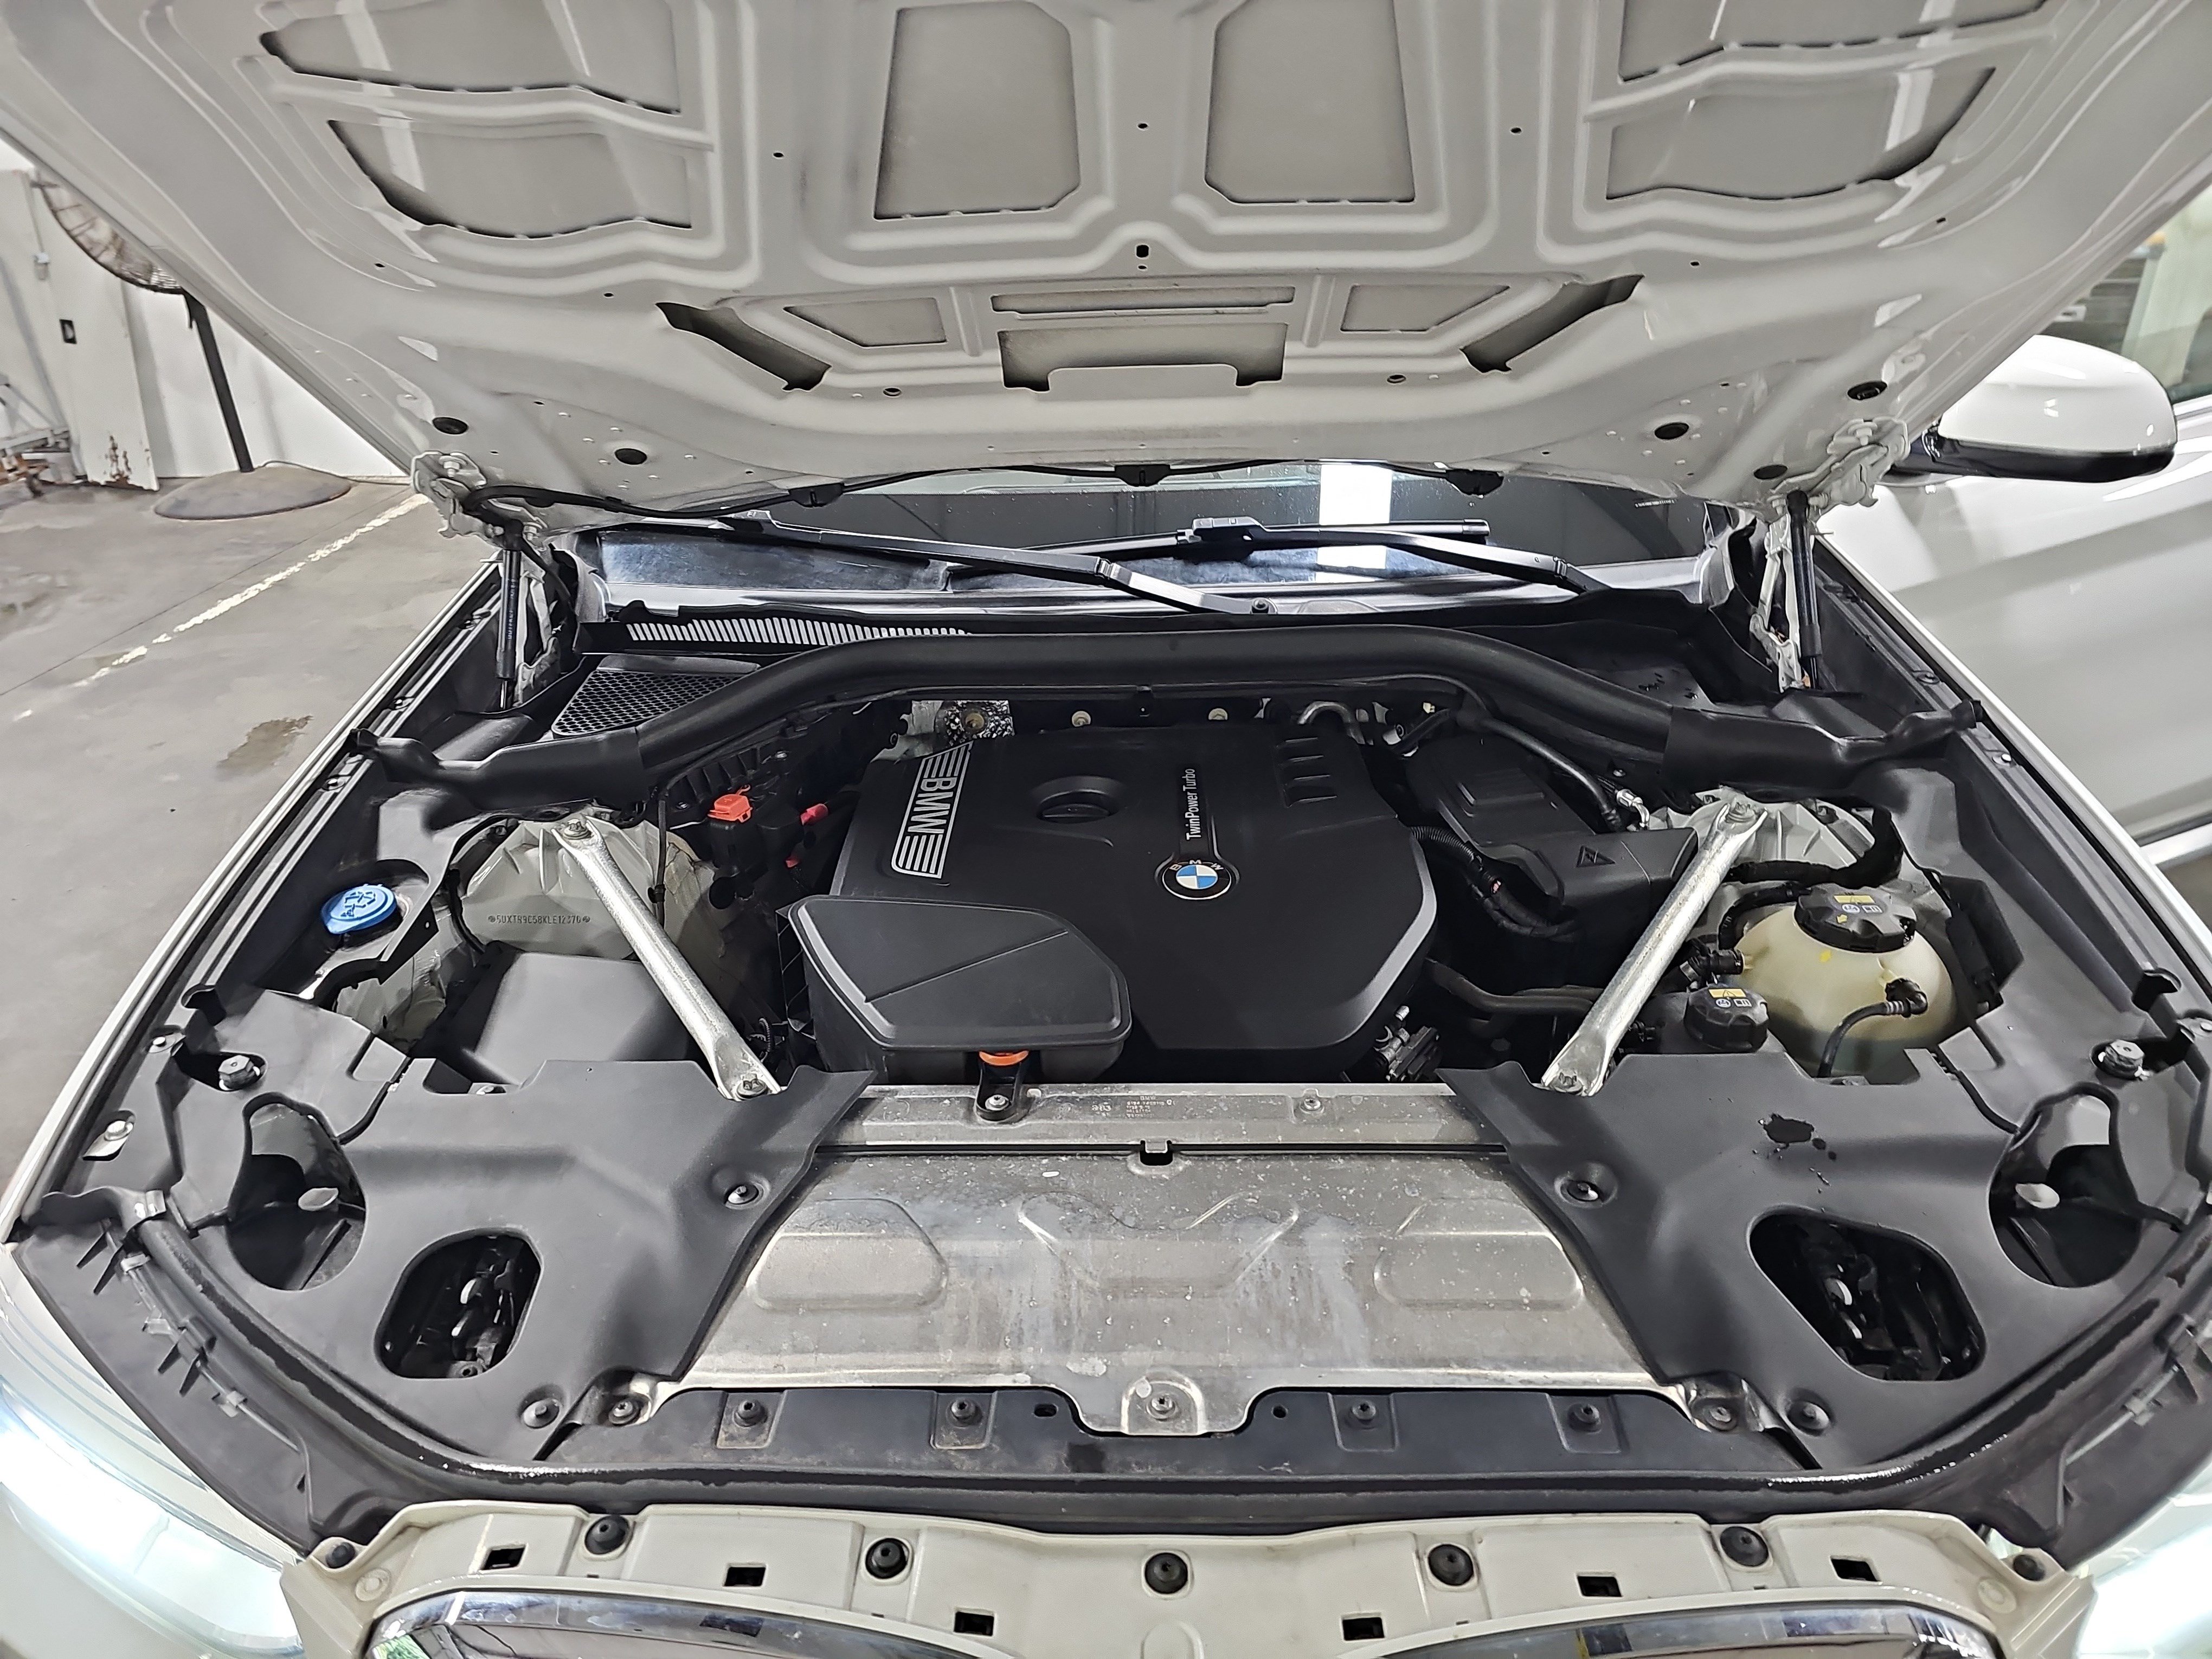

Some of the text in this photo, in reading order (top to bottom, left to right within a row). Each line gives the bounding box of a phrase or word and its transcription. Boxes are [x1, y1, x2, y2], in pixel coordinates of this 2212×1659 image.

[907, 776, 958, 834] BMW
[1182, 768, 1202, 840] TwinPower Turbo
[1169, 859, 1224, 871] BMW
